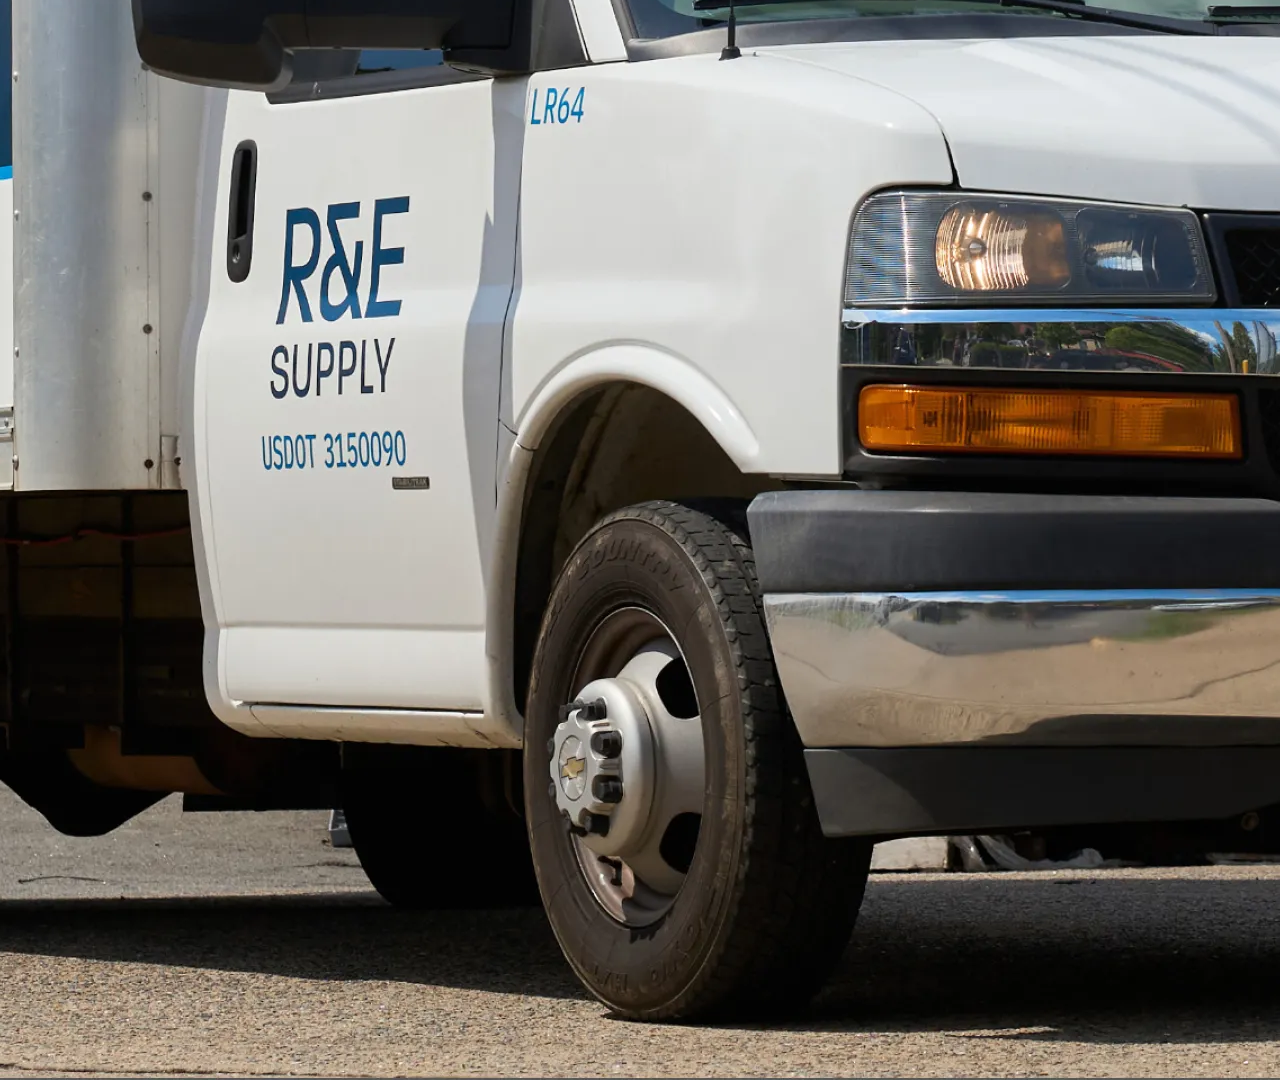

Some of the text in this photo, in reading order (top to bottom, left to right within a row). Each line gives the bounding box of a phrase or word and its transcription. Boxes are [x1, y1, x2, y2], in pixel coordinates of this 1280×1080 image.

[530, 86, 586, 125] LR64
[275, 195, 411, 325] R&E
[269, 337, 396, 399] SUPPLY
[261, 430, 407, 470] USDOT 3150090
